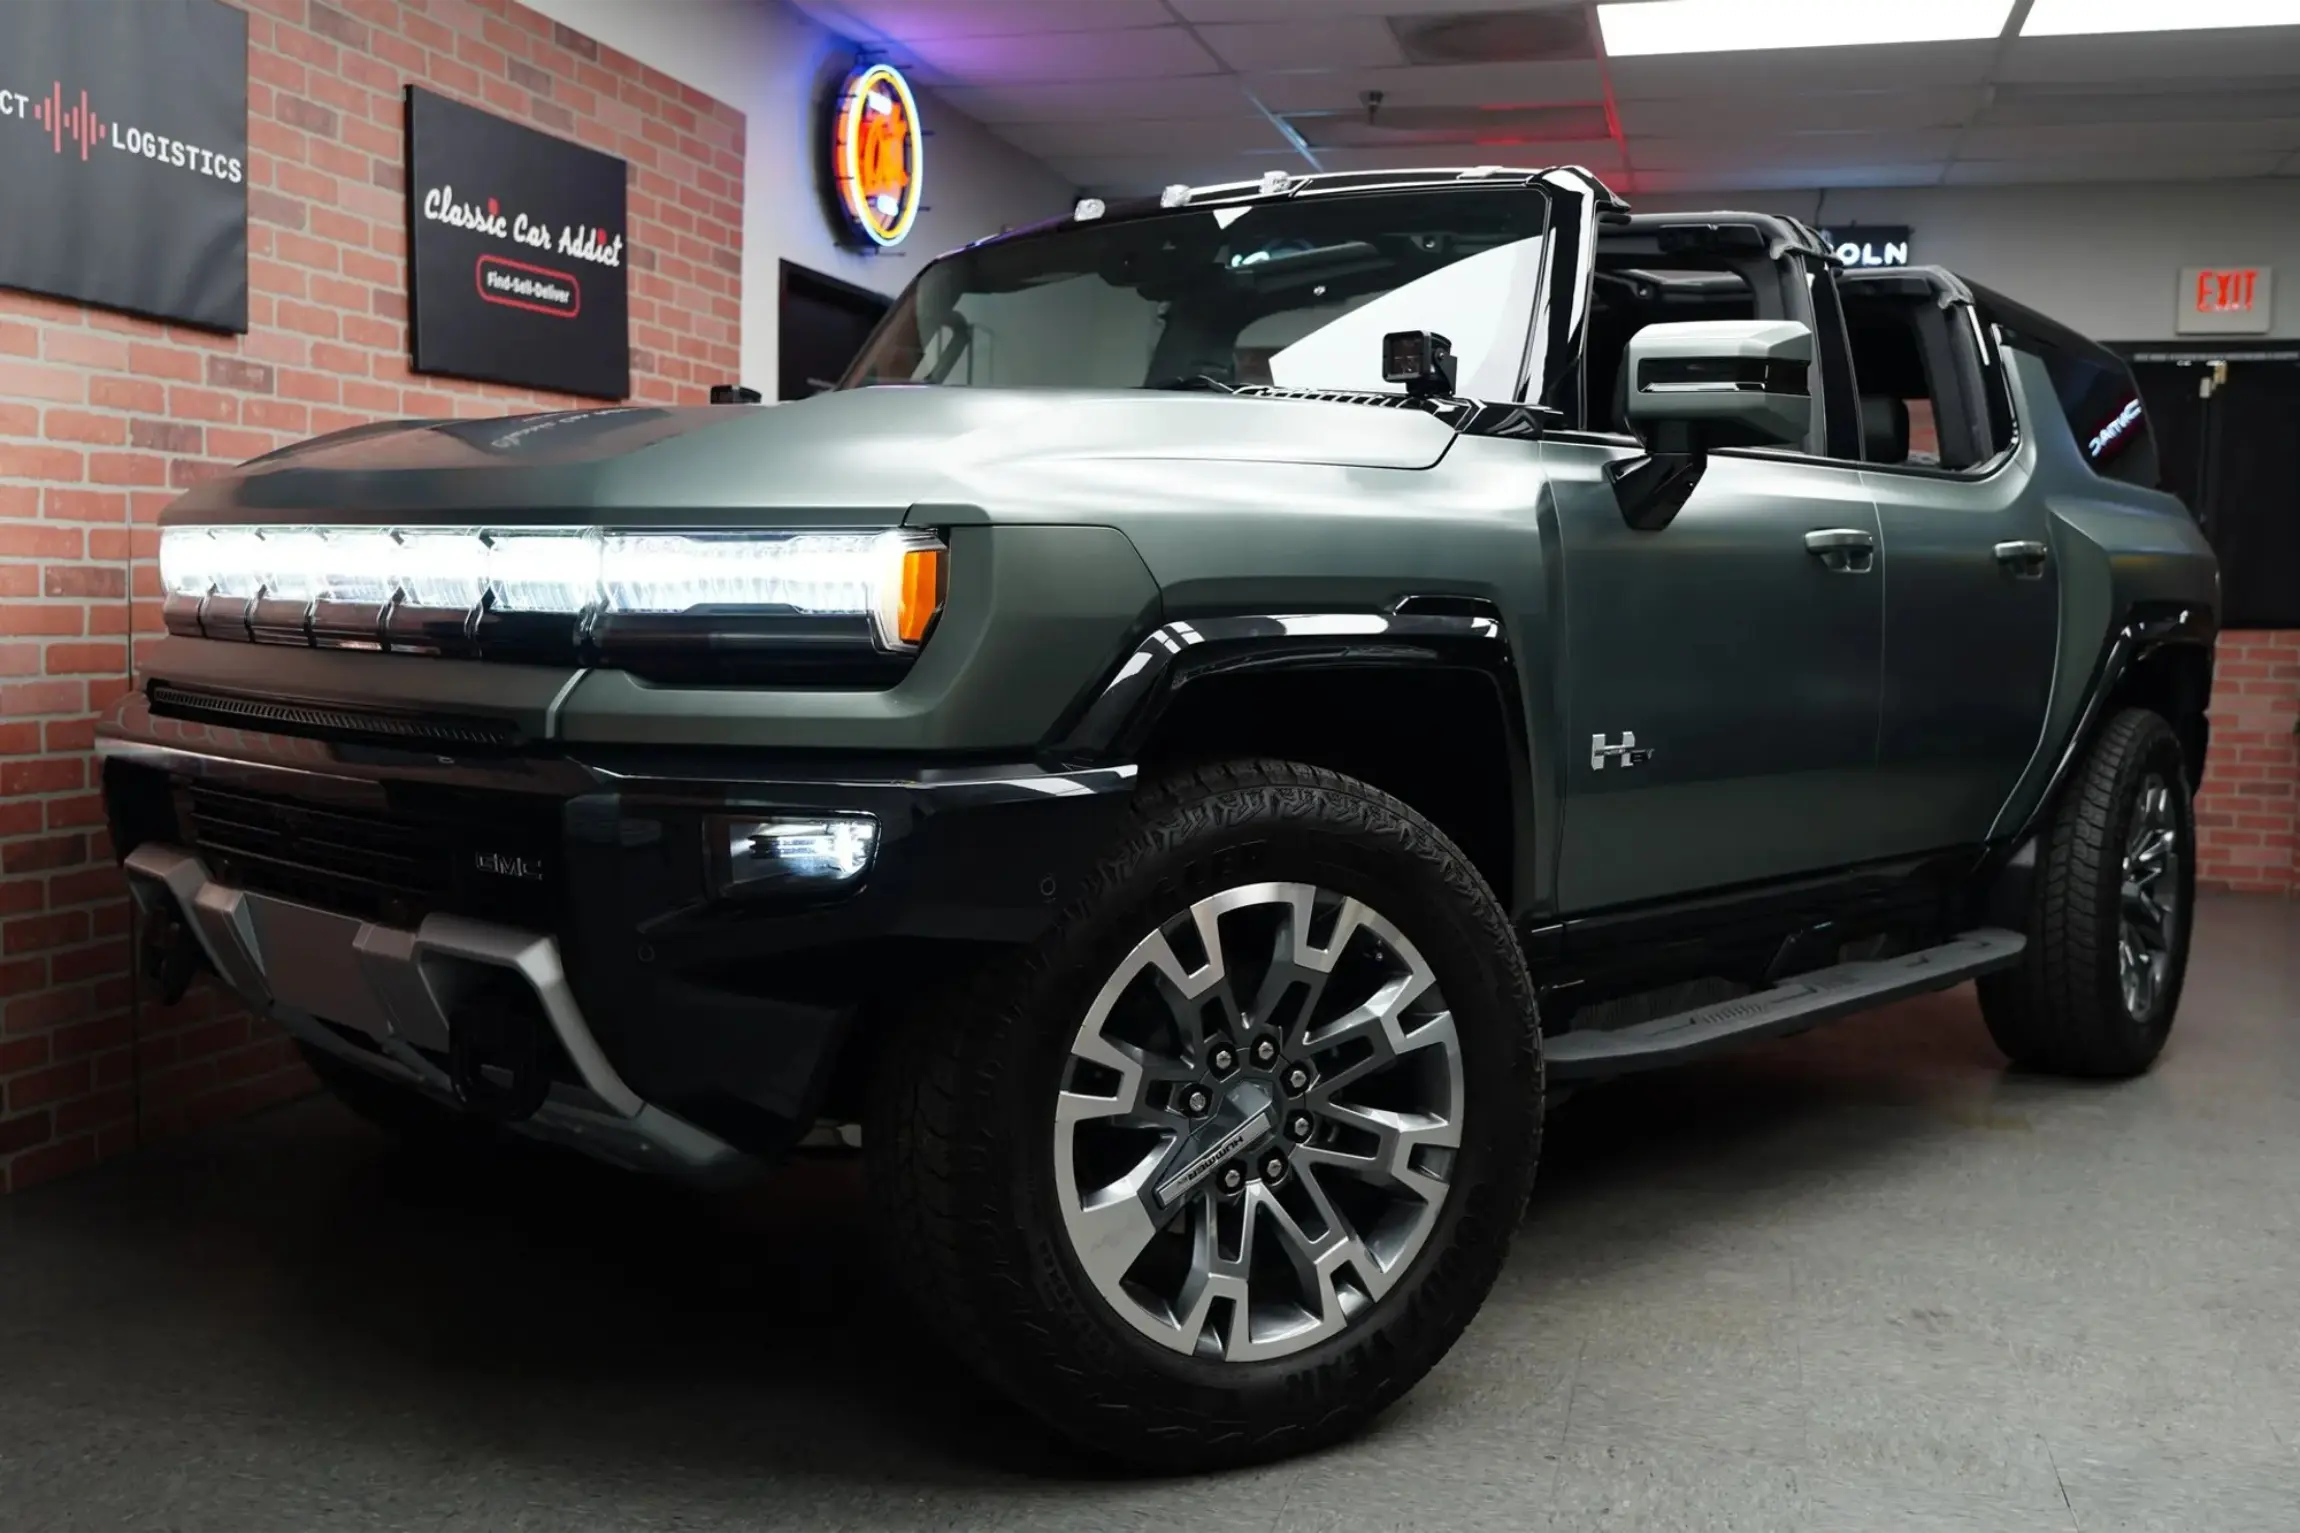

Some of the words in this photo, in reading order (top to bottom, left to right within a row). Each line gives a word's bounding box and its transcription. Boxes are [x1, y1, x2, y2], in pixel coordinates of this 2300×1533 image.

[112, 122, 242, 183] LOGISTICS
[424, 184, 507, 239] Classic
[513, 213, 552, 250] Car
[557, 224, 623, 267] Addict
[2196, 269, 2257, 312] EXIT
[475, 851, 543, 881] GMC
[1187, 1136, 1244, 1181] HUMMER
